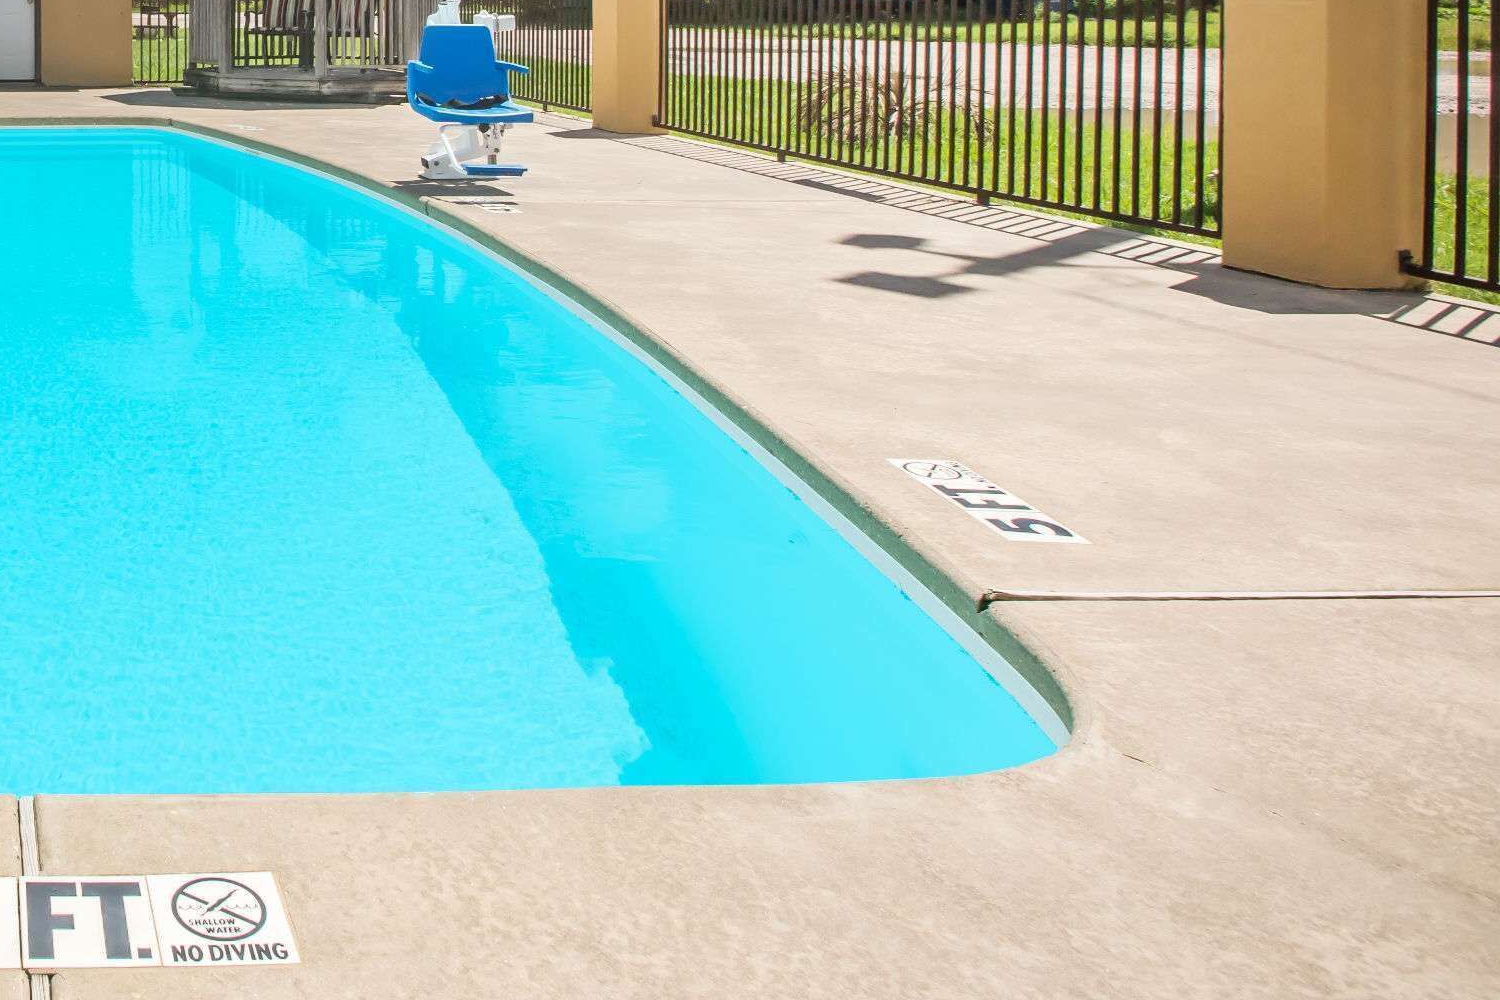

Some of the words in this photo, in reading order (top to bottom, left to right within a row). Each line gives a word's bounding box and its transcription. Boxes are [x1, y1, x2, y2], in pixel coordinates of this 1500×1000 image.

[985, 518, 1074, 537] 5
[25, 881, 153, 960] FT.
[188, 918, 235, 926] SHALLOW
[205, 926, 242, 934] WATER
[171, 944, 204, 962] NO
[208, 942, 289, 961] DIVING
